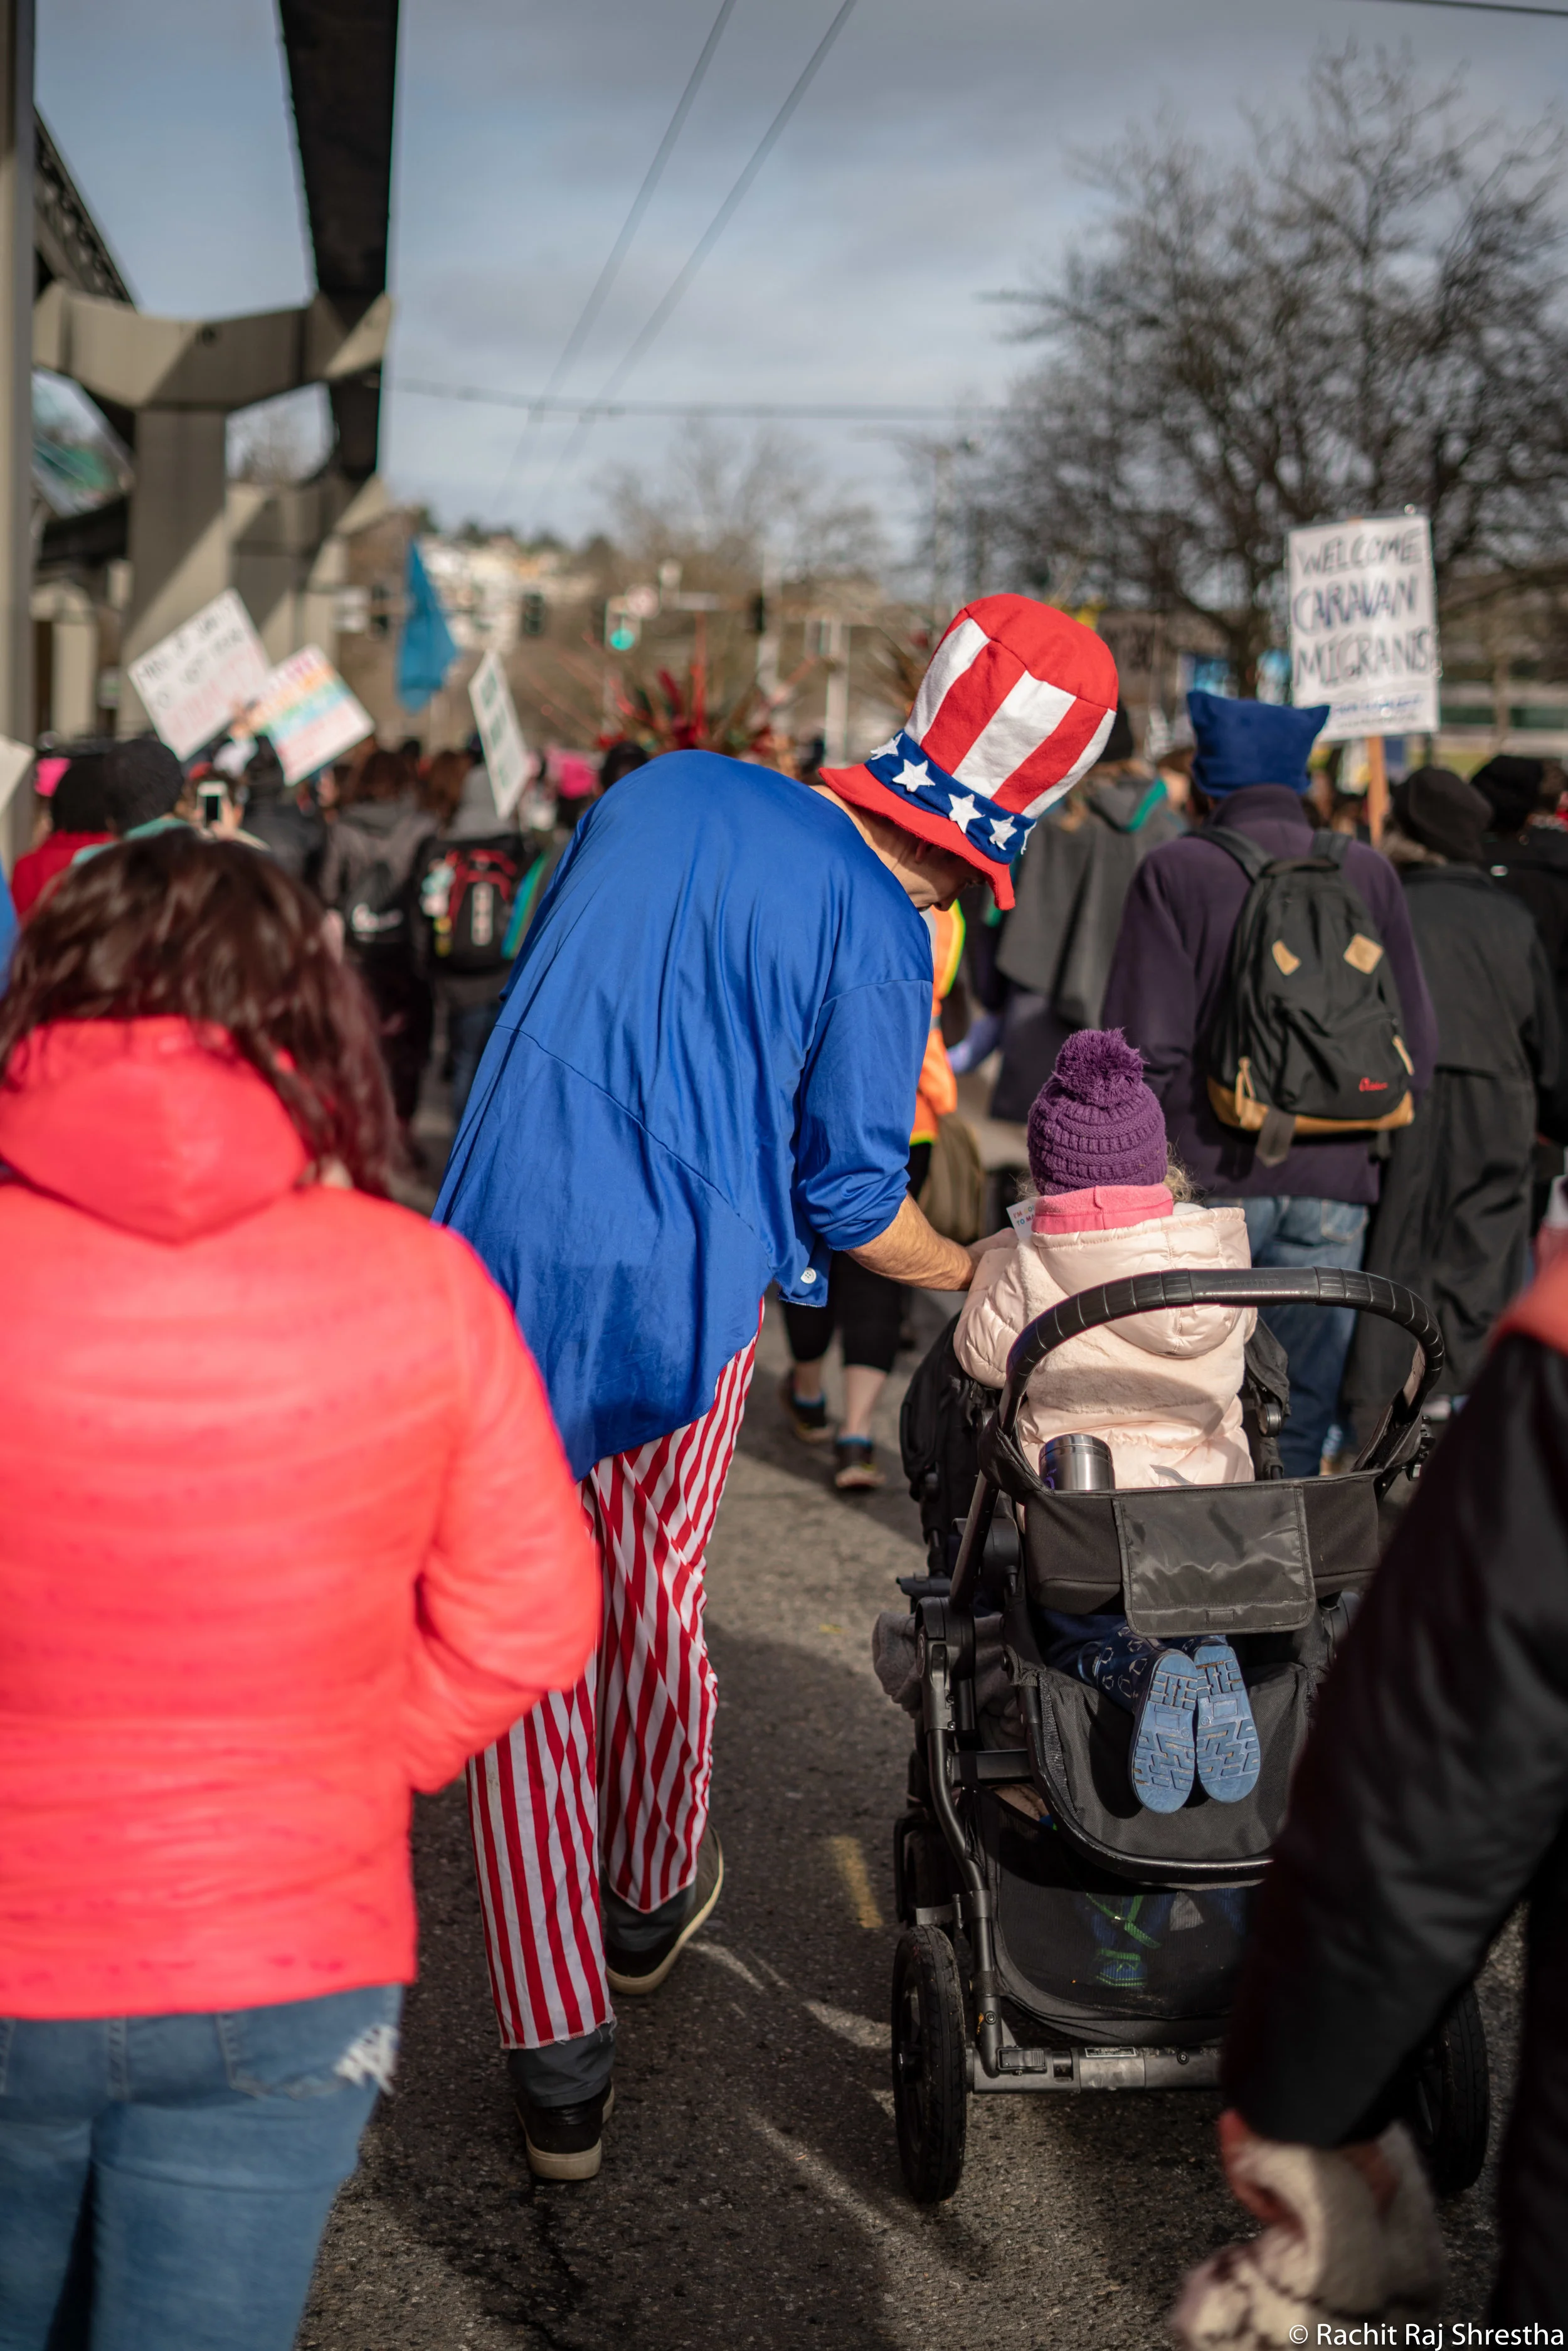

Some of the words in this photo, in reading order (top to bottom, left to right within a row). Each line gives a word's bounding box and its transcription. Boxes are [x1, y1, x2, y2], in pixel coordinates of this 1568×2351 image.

[1296, 526, 1423, 576] WELCOME
[1292, 574, 1417, 636] CARAVAN
[1294, 627, 1429, 687] MIGRANTS
[1013, 1211, 1022, 1219] I'M
